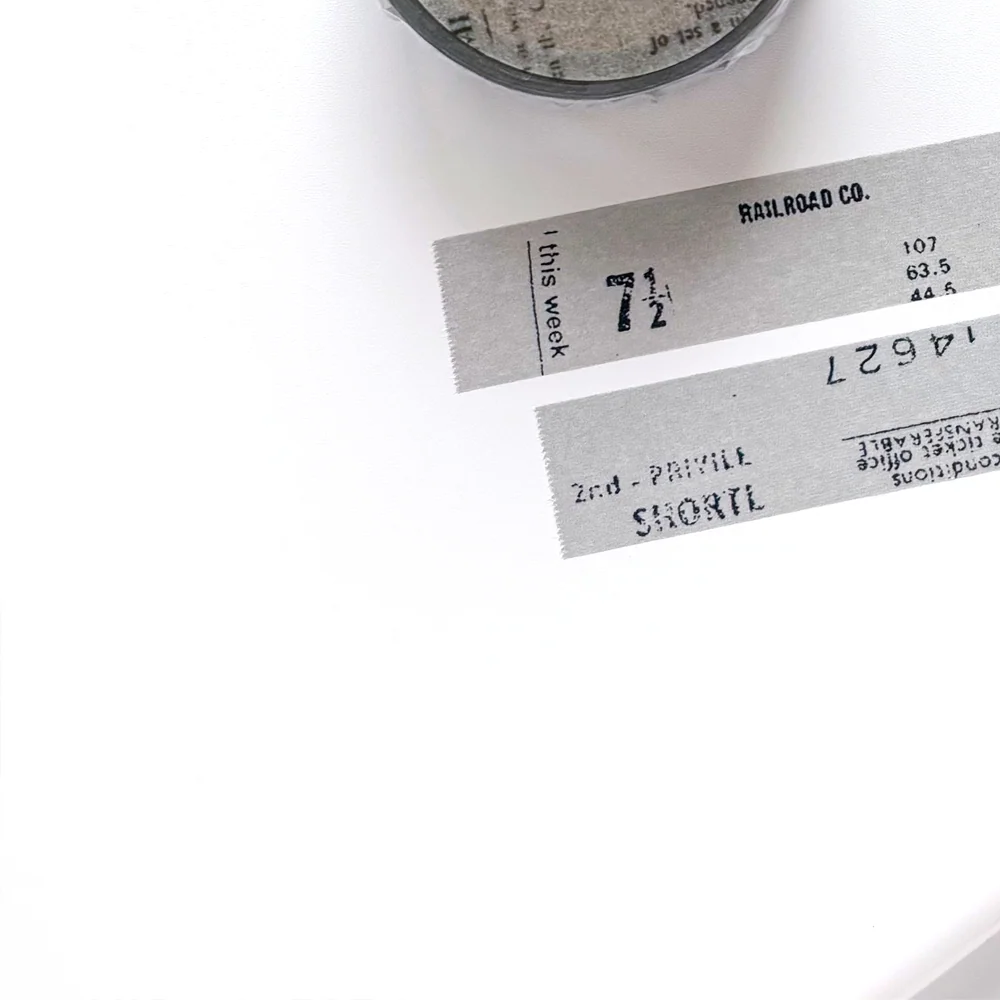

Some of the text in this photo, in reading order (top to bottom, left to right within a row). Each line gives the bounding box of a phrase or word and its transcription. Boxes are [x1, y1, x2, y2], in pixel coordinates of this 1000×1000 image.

[650, 36, 670, 56] of
[678, 27, 703, 45] set
[738, 182, 871, 225] RAILROAD CO.
[903, 235, 938, 255] 107
[538, 243, 561, 288] this
[906, 257, 952, 281] 63.5
[544, 294, 570, 359] week
[856, 449, 913, 472] office
